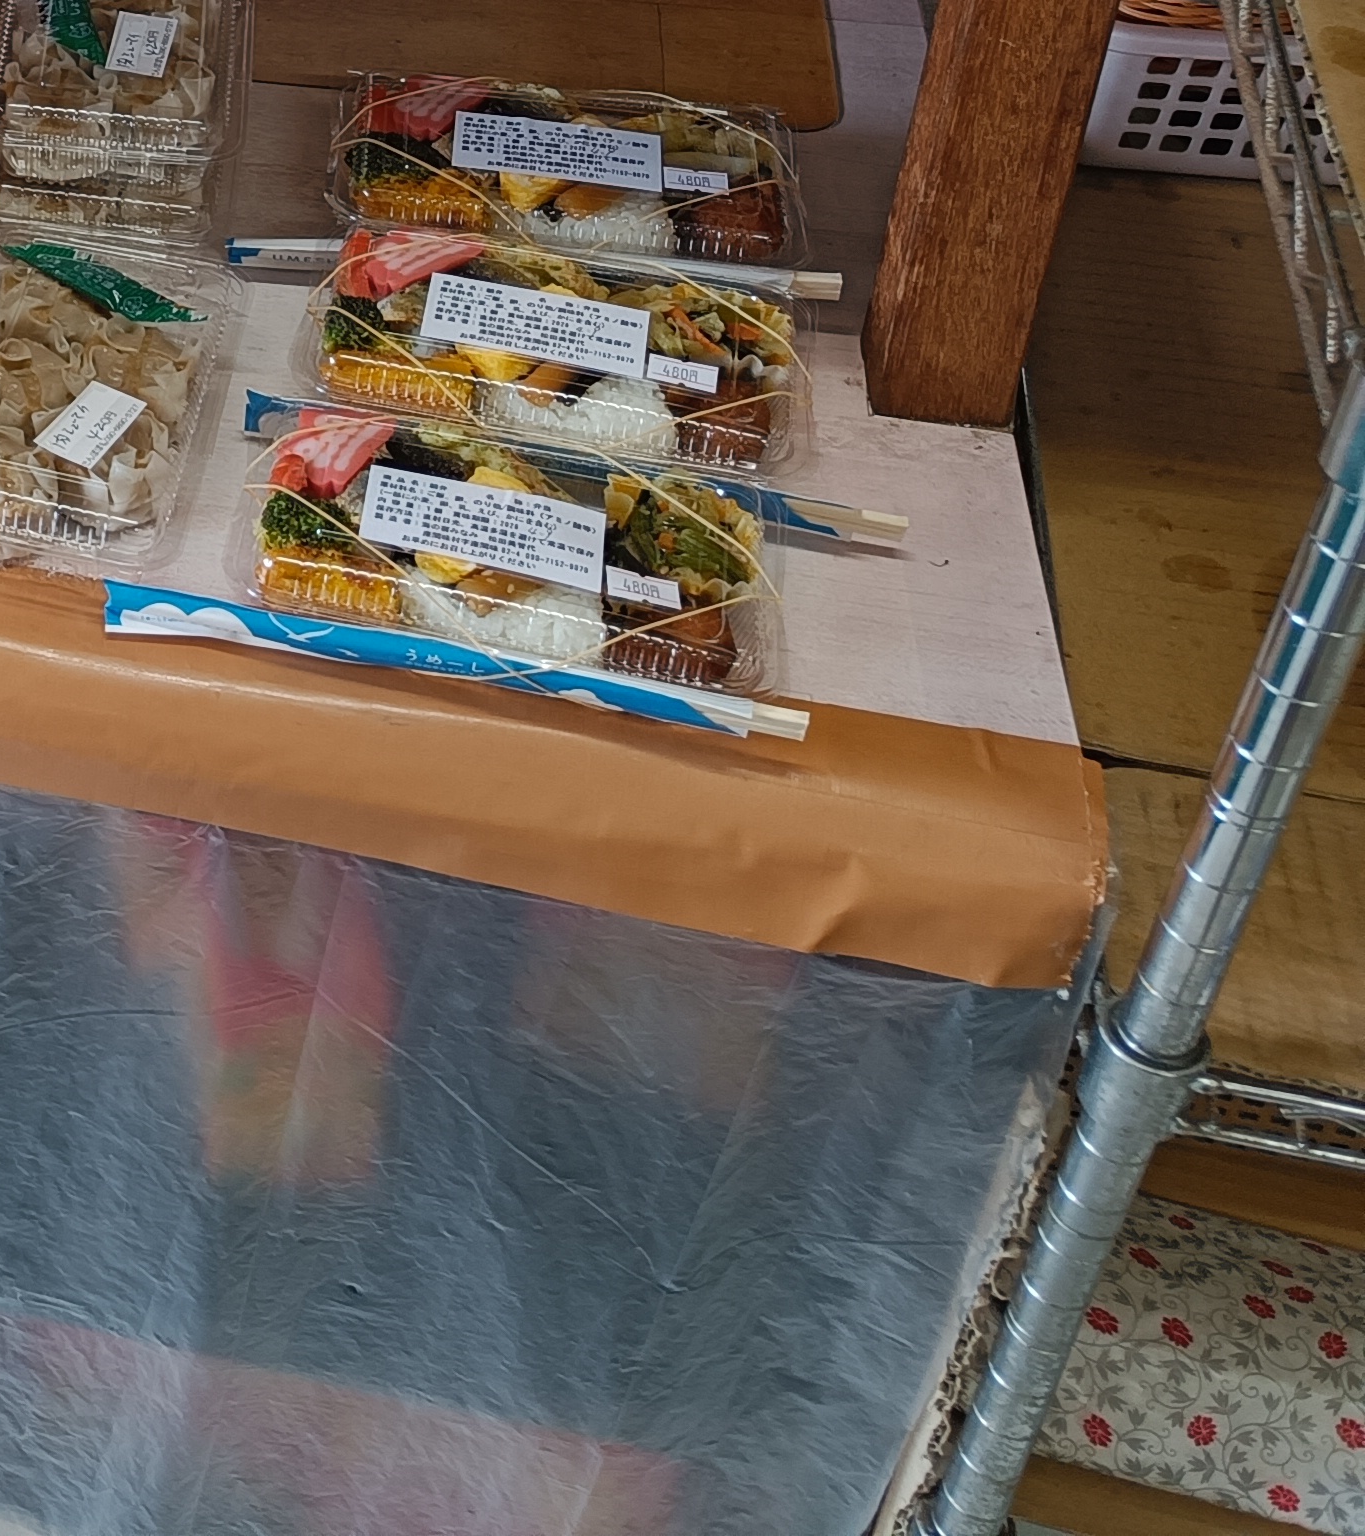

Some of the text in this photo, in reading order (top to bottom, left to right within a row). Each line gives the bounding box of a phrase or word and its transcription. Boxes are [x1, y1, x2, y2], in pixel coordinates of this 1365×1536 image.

[675, 174, 711, 189] 480円
[662, 365, 699, 383] 480円
[622, 576, 660, 596] 480円
